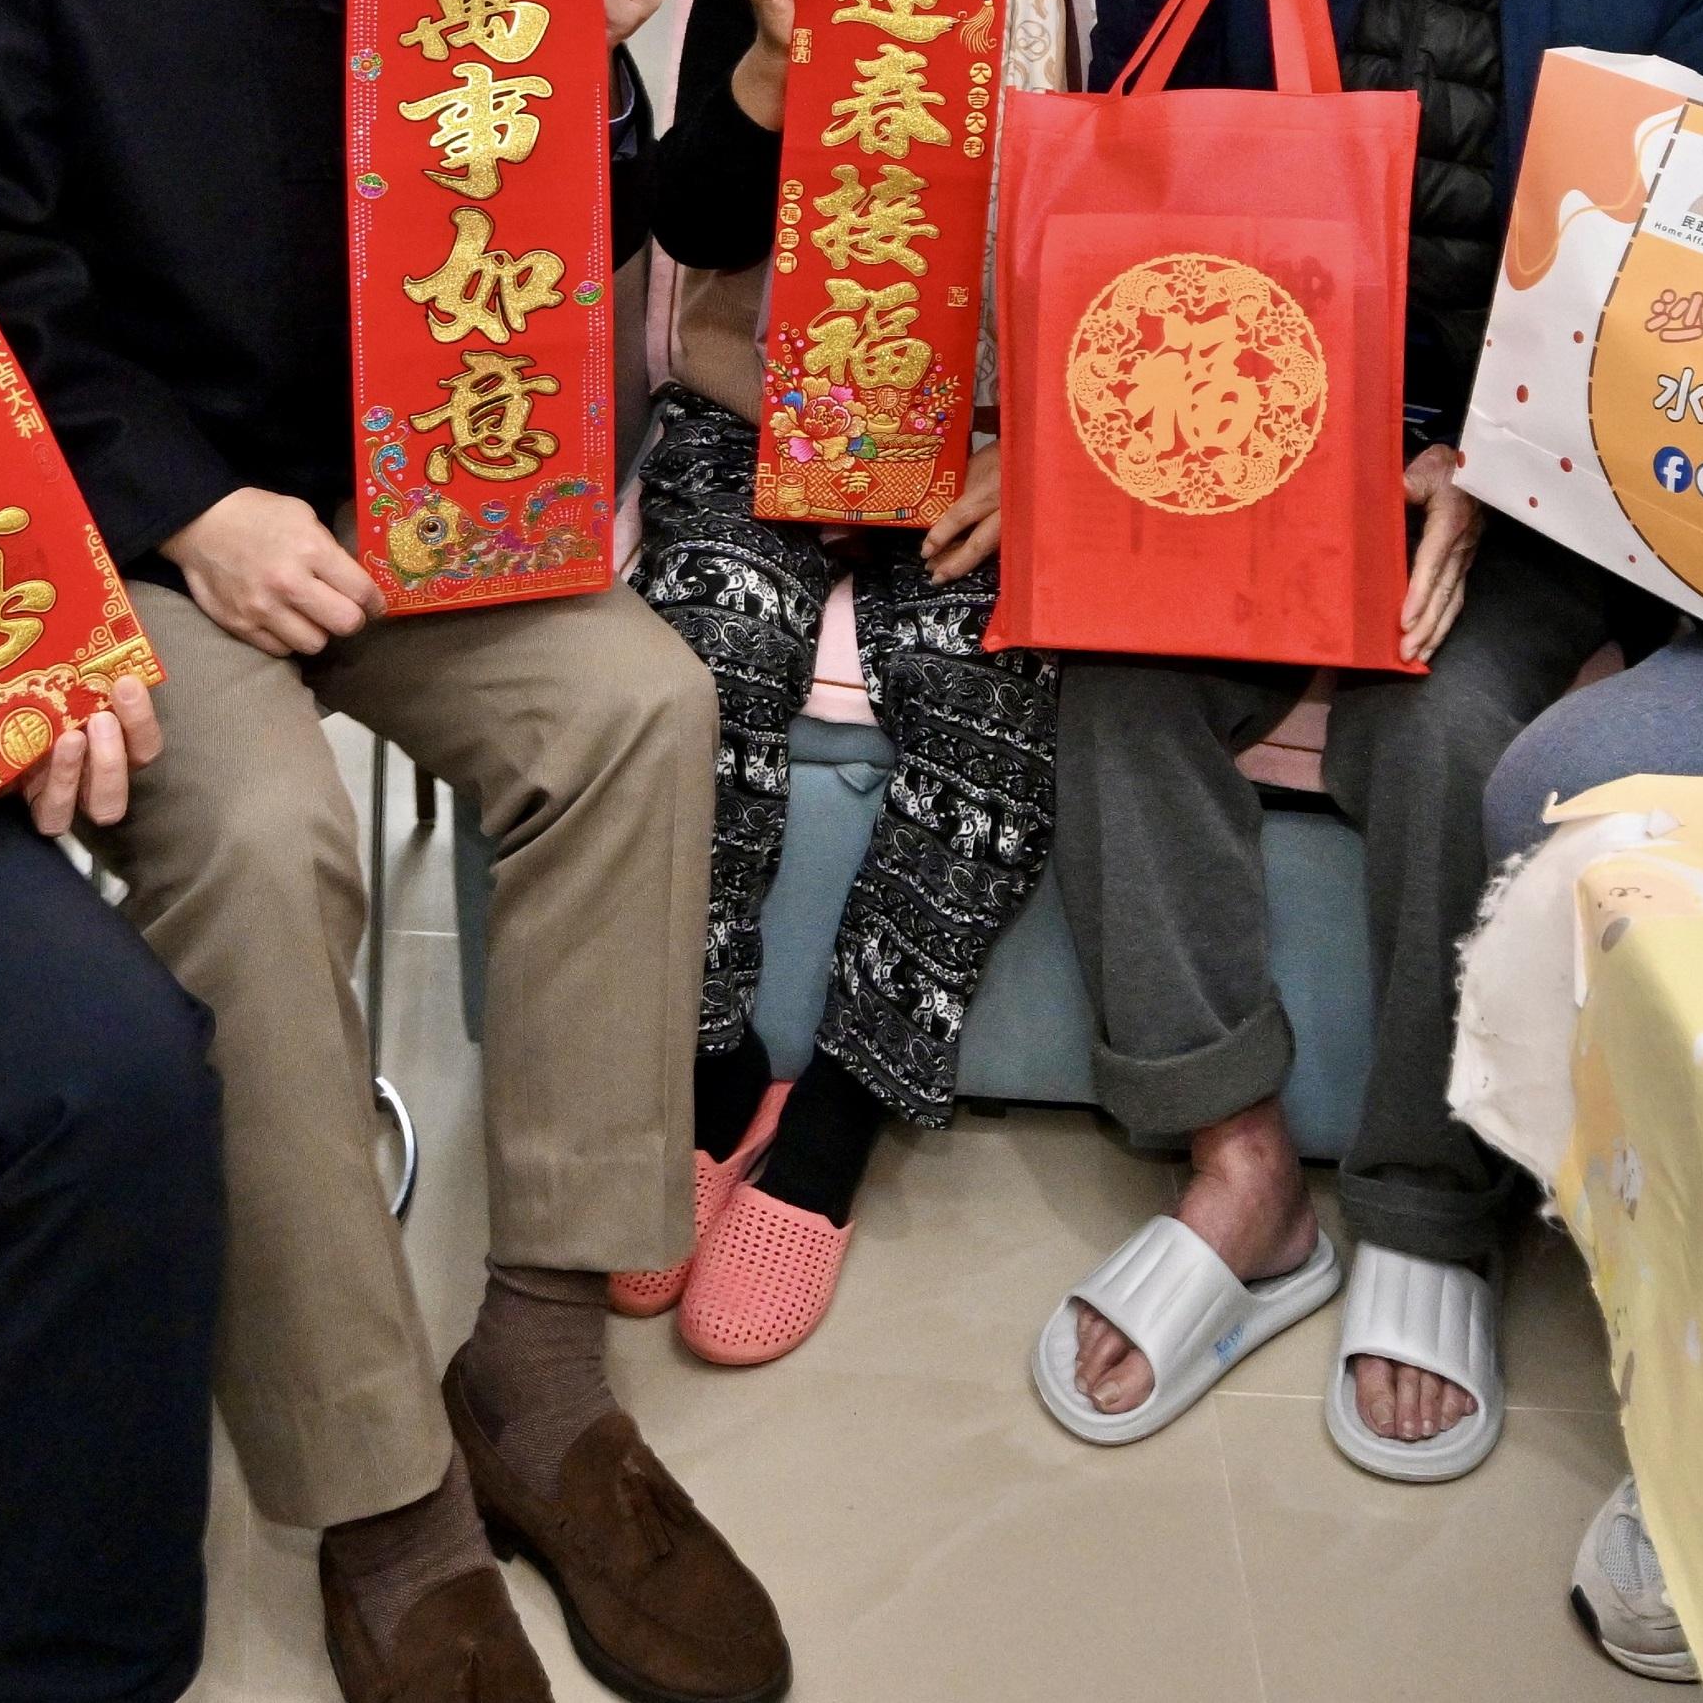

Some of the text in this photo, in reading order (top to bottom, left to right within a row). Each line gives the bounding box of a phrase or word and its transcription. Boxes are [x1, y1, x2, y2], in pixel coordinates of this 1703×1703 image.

[964, 63, 992, 157] 大吉大利
[777, 181, 803, 273] 五福臨門
[1654, 222, 1682, 239] Home
